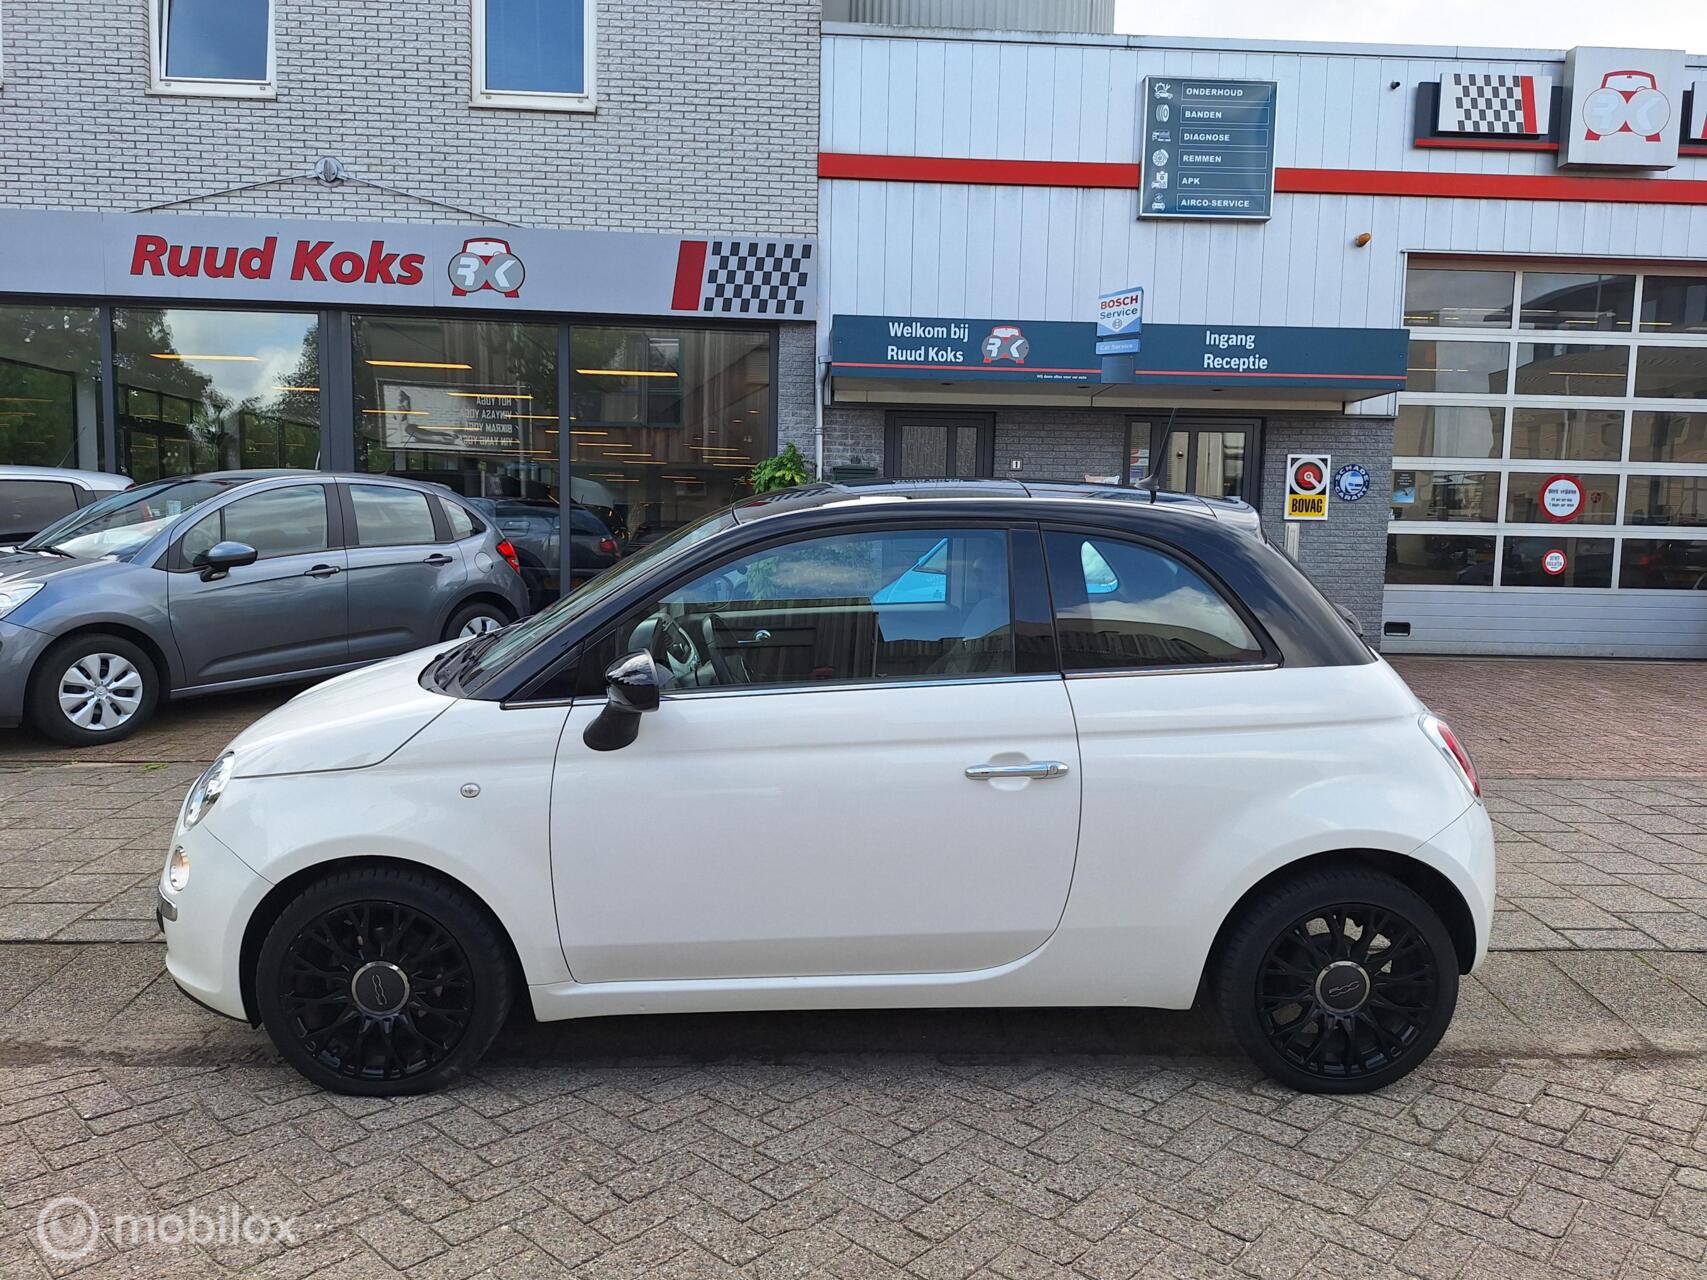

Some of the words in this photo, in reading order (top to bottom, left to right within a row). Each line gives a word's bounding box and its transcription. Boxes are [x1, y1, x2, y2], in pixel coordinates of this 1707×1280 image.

[1186, 87, 1243, 96] ONDERHOUD
[1185, 110, 1222, 119] BANDEN
[1183, 133, 1230, 142] DIAGNOSE
[1182, 154, 1222, 163] REMMEN
[1181, 177, 1201, 185] APK
[1180, 199, 1250, 207] AIRCO-SERVICE
[130, 234, 278, 280] Ruud
[290, 240, 425, 286] Koks
[1100, 294, 1139, 310] BOSCH
[1099, 307, 1138, 320] Service
[888, 321, 947, 338] Welkom
[950, 323, 969, 343] bij
[1205, 330, 1256, 349] Ingang
[887, 345, 925, 361] Ruud
[928, 346, 964, 362] Koks
[1203, 353, 1268, 372] Receptie
[1291, 498, 1323, 513] BOVAG
